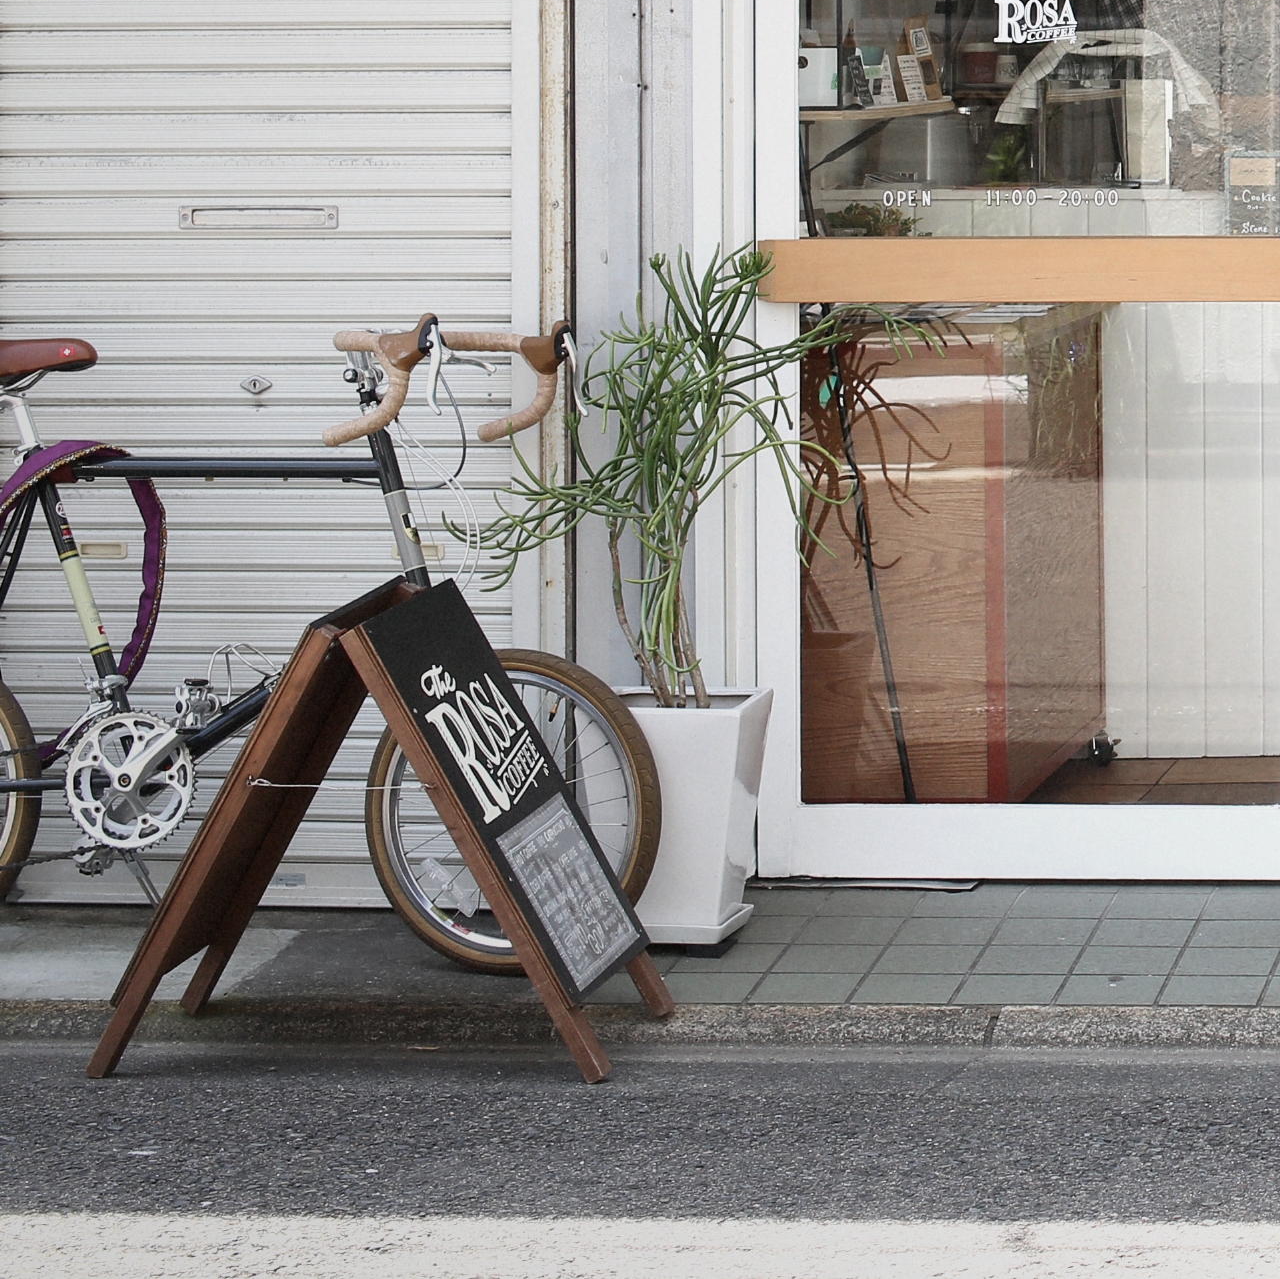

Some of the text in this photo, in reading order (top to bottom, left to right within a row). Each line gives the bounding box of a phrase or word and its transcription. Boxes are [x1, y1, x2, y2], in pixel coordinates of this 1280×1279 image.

[1026, 27, 1076, 42] COFFEE
[882, 190, 932, 207] OPEN
[1242, 189, 1277, 204] Cookie
[420, 664, 456, 700] The
[425, 672, 525, 824] ROSA
[502, 736, 540, 797] COFFEE
